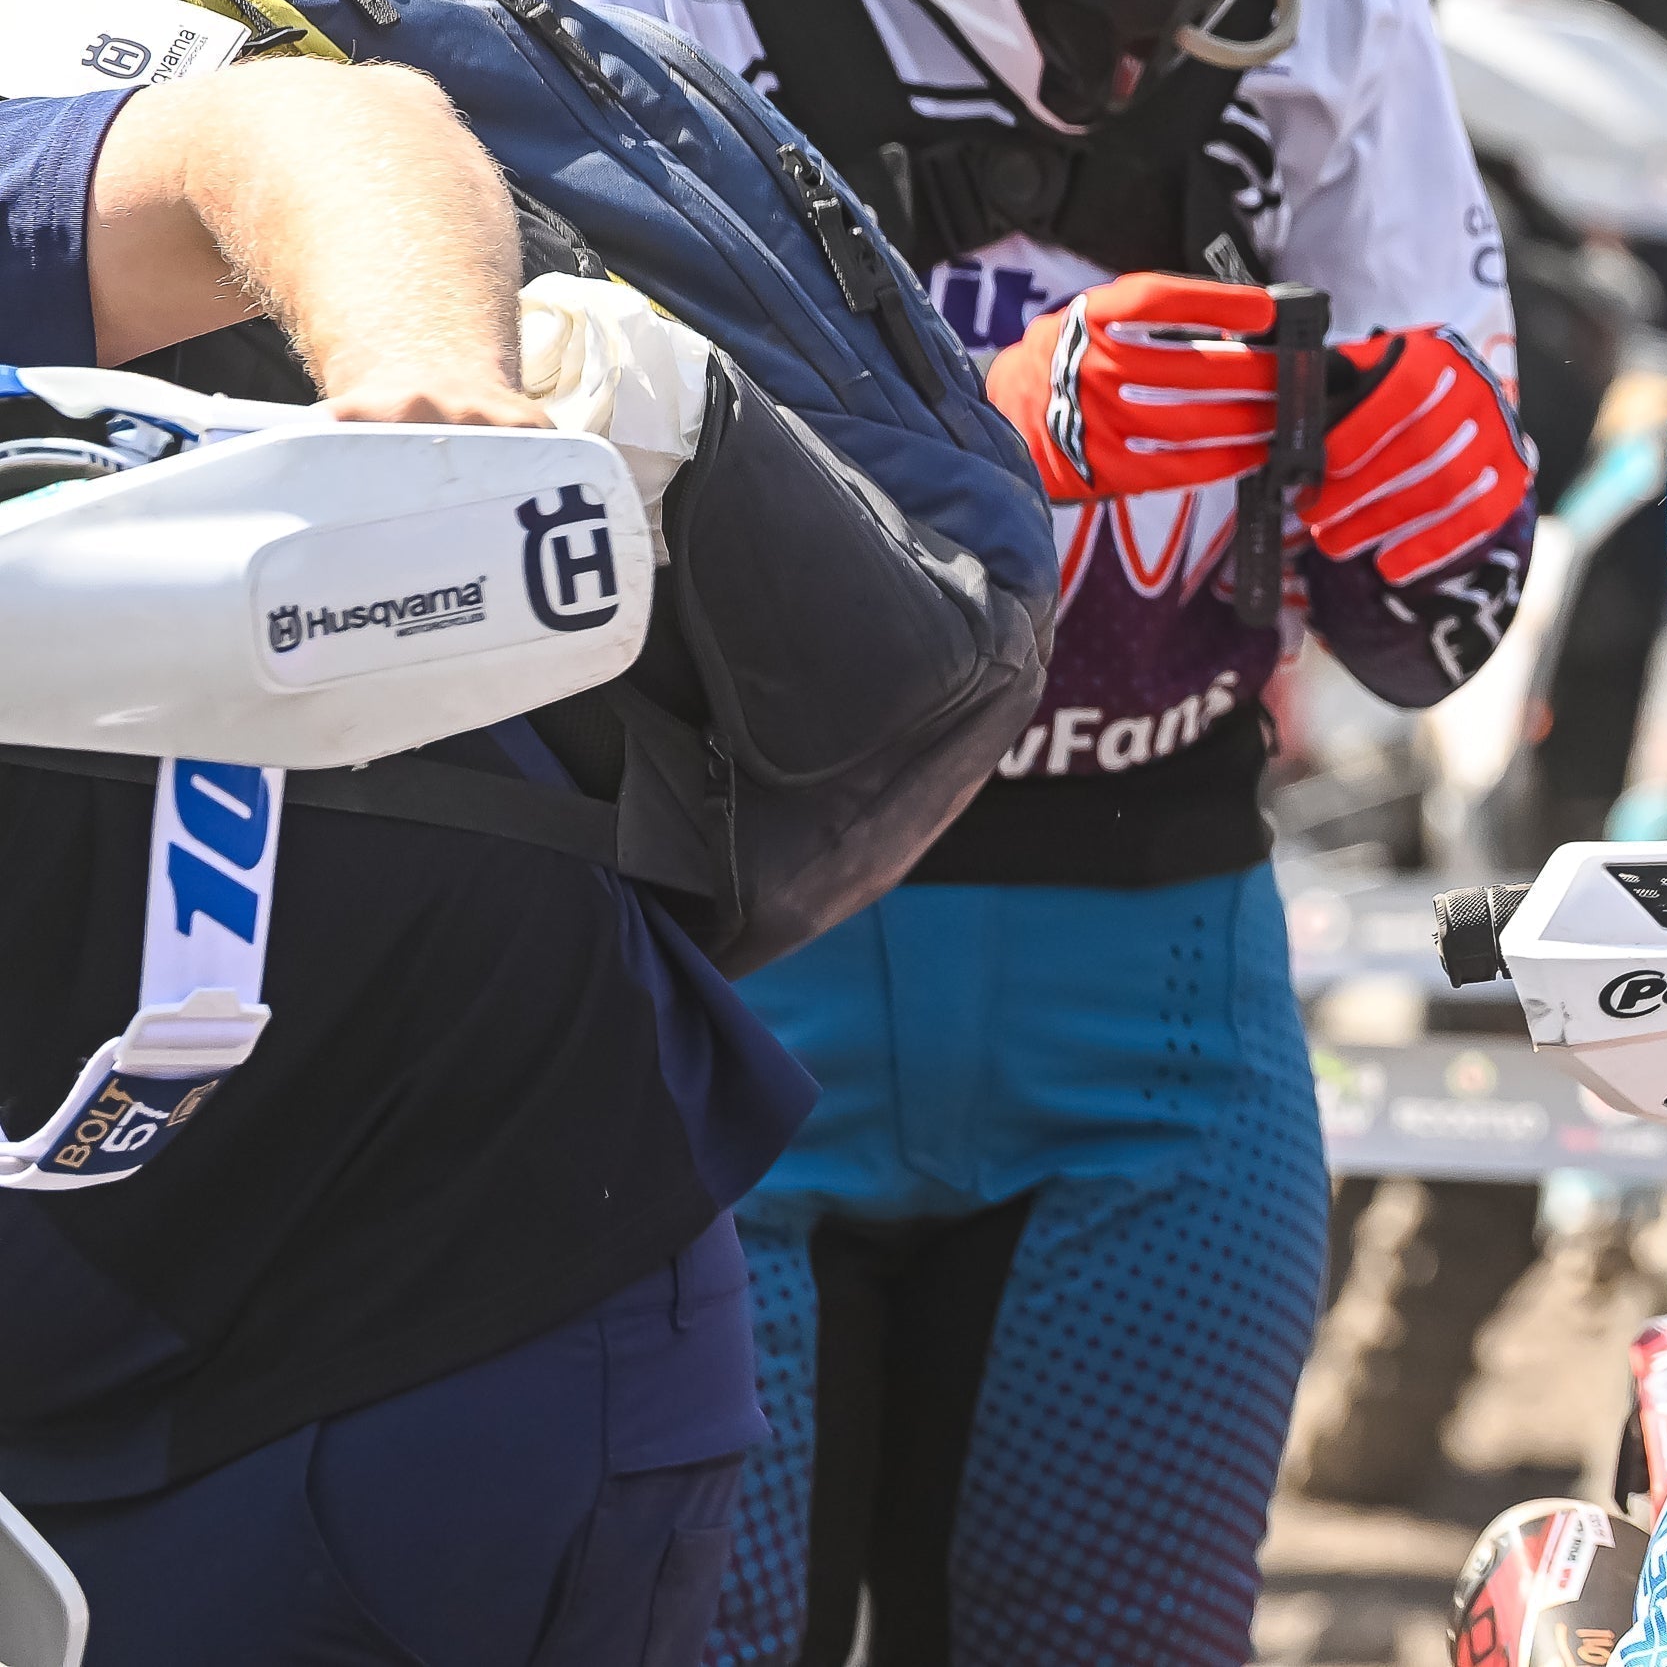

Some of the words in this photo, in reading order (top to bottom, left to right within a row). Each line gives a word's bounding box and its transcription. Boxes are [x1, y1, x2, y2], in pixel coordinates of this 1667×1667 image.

[150, 27, 196, 84] qvarna
[306, 582, 484, 638] Husqvarna
[54, 1077, 137, 1169] BOLT
